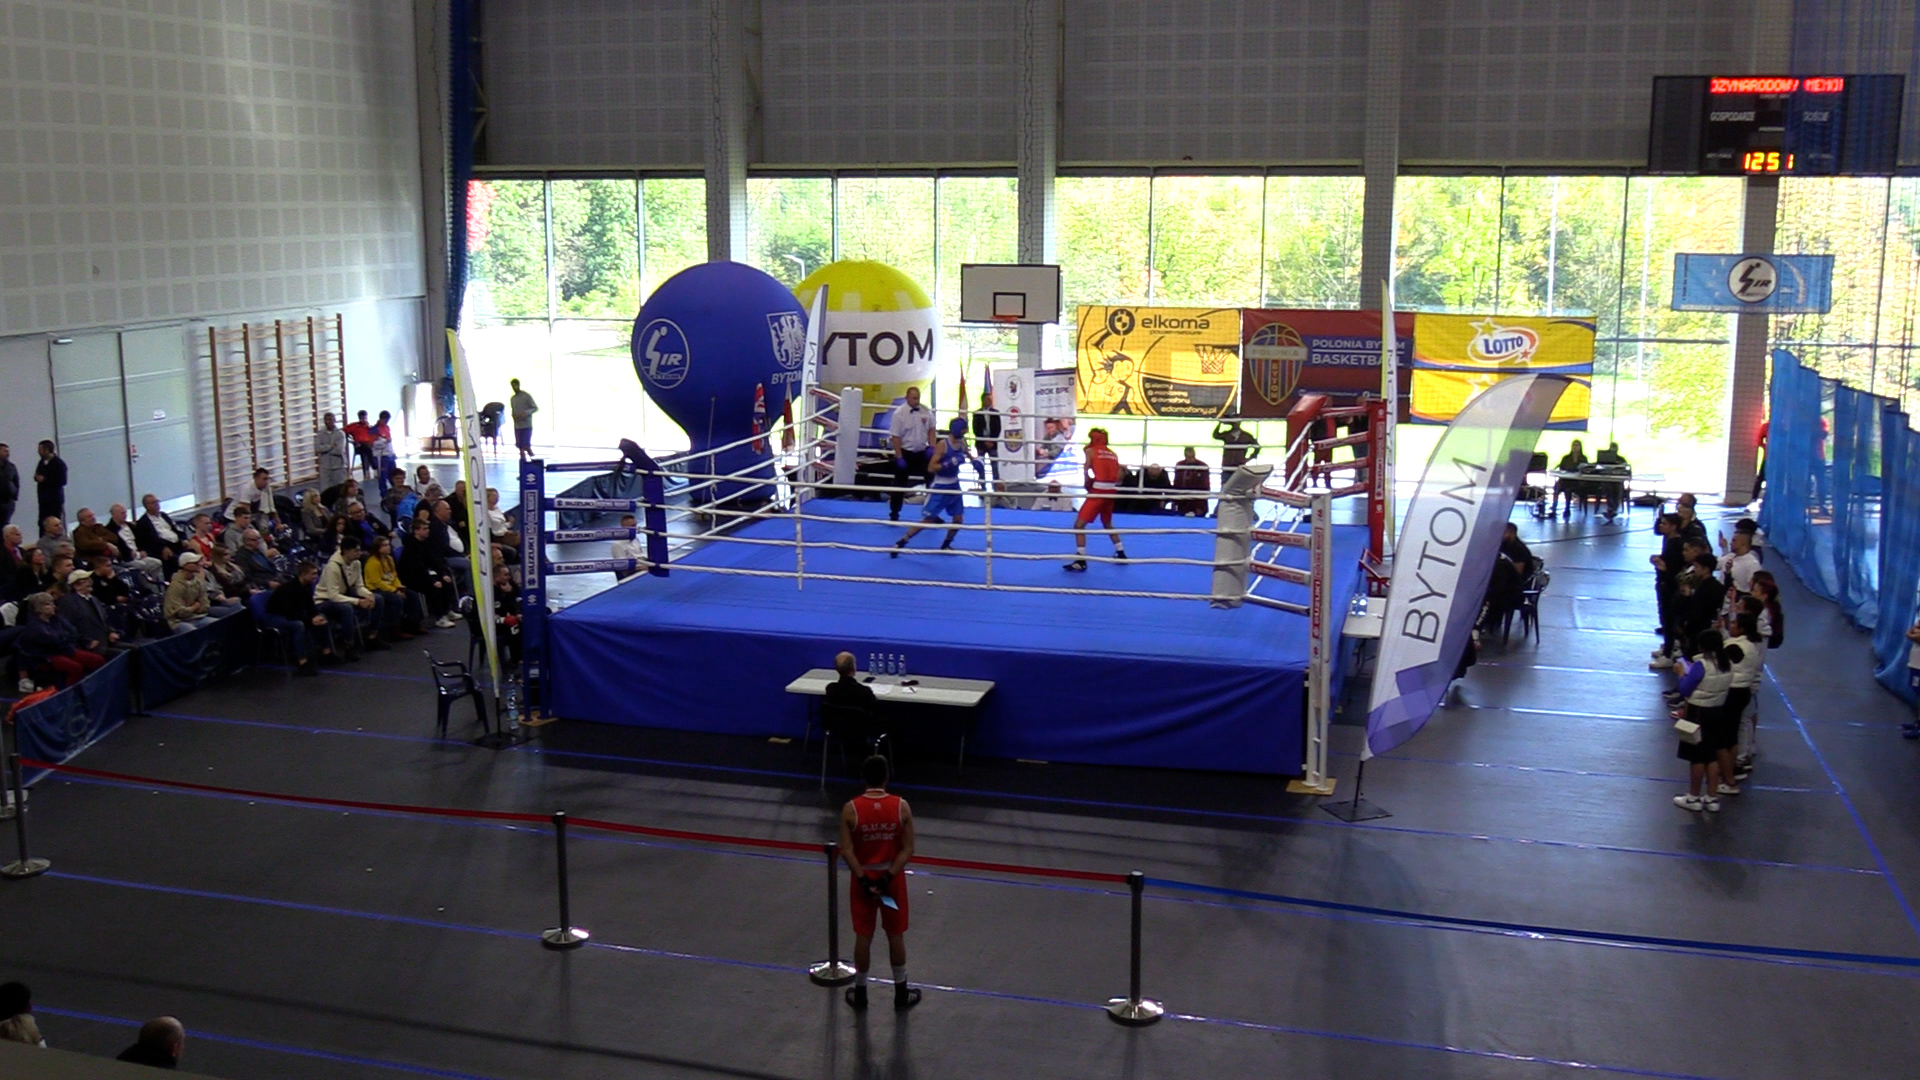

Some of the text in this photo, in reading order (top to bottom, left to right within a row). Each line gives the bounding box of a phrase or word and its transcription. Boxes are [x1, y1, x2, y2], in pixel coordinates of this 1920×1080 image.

[1141, 314, 1210, 330] elkoma
[822, 328, 934, 366] YTOM
[1312, 339, 1405, 350] POLONIA BYM
[1483, 335, 1523, 354] LOTTO
[1312, 354, 1404, 366] BASKETBAL
[1401, 457, 1488, 643] BYTOM
